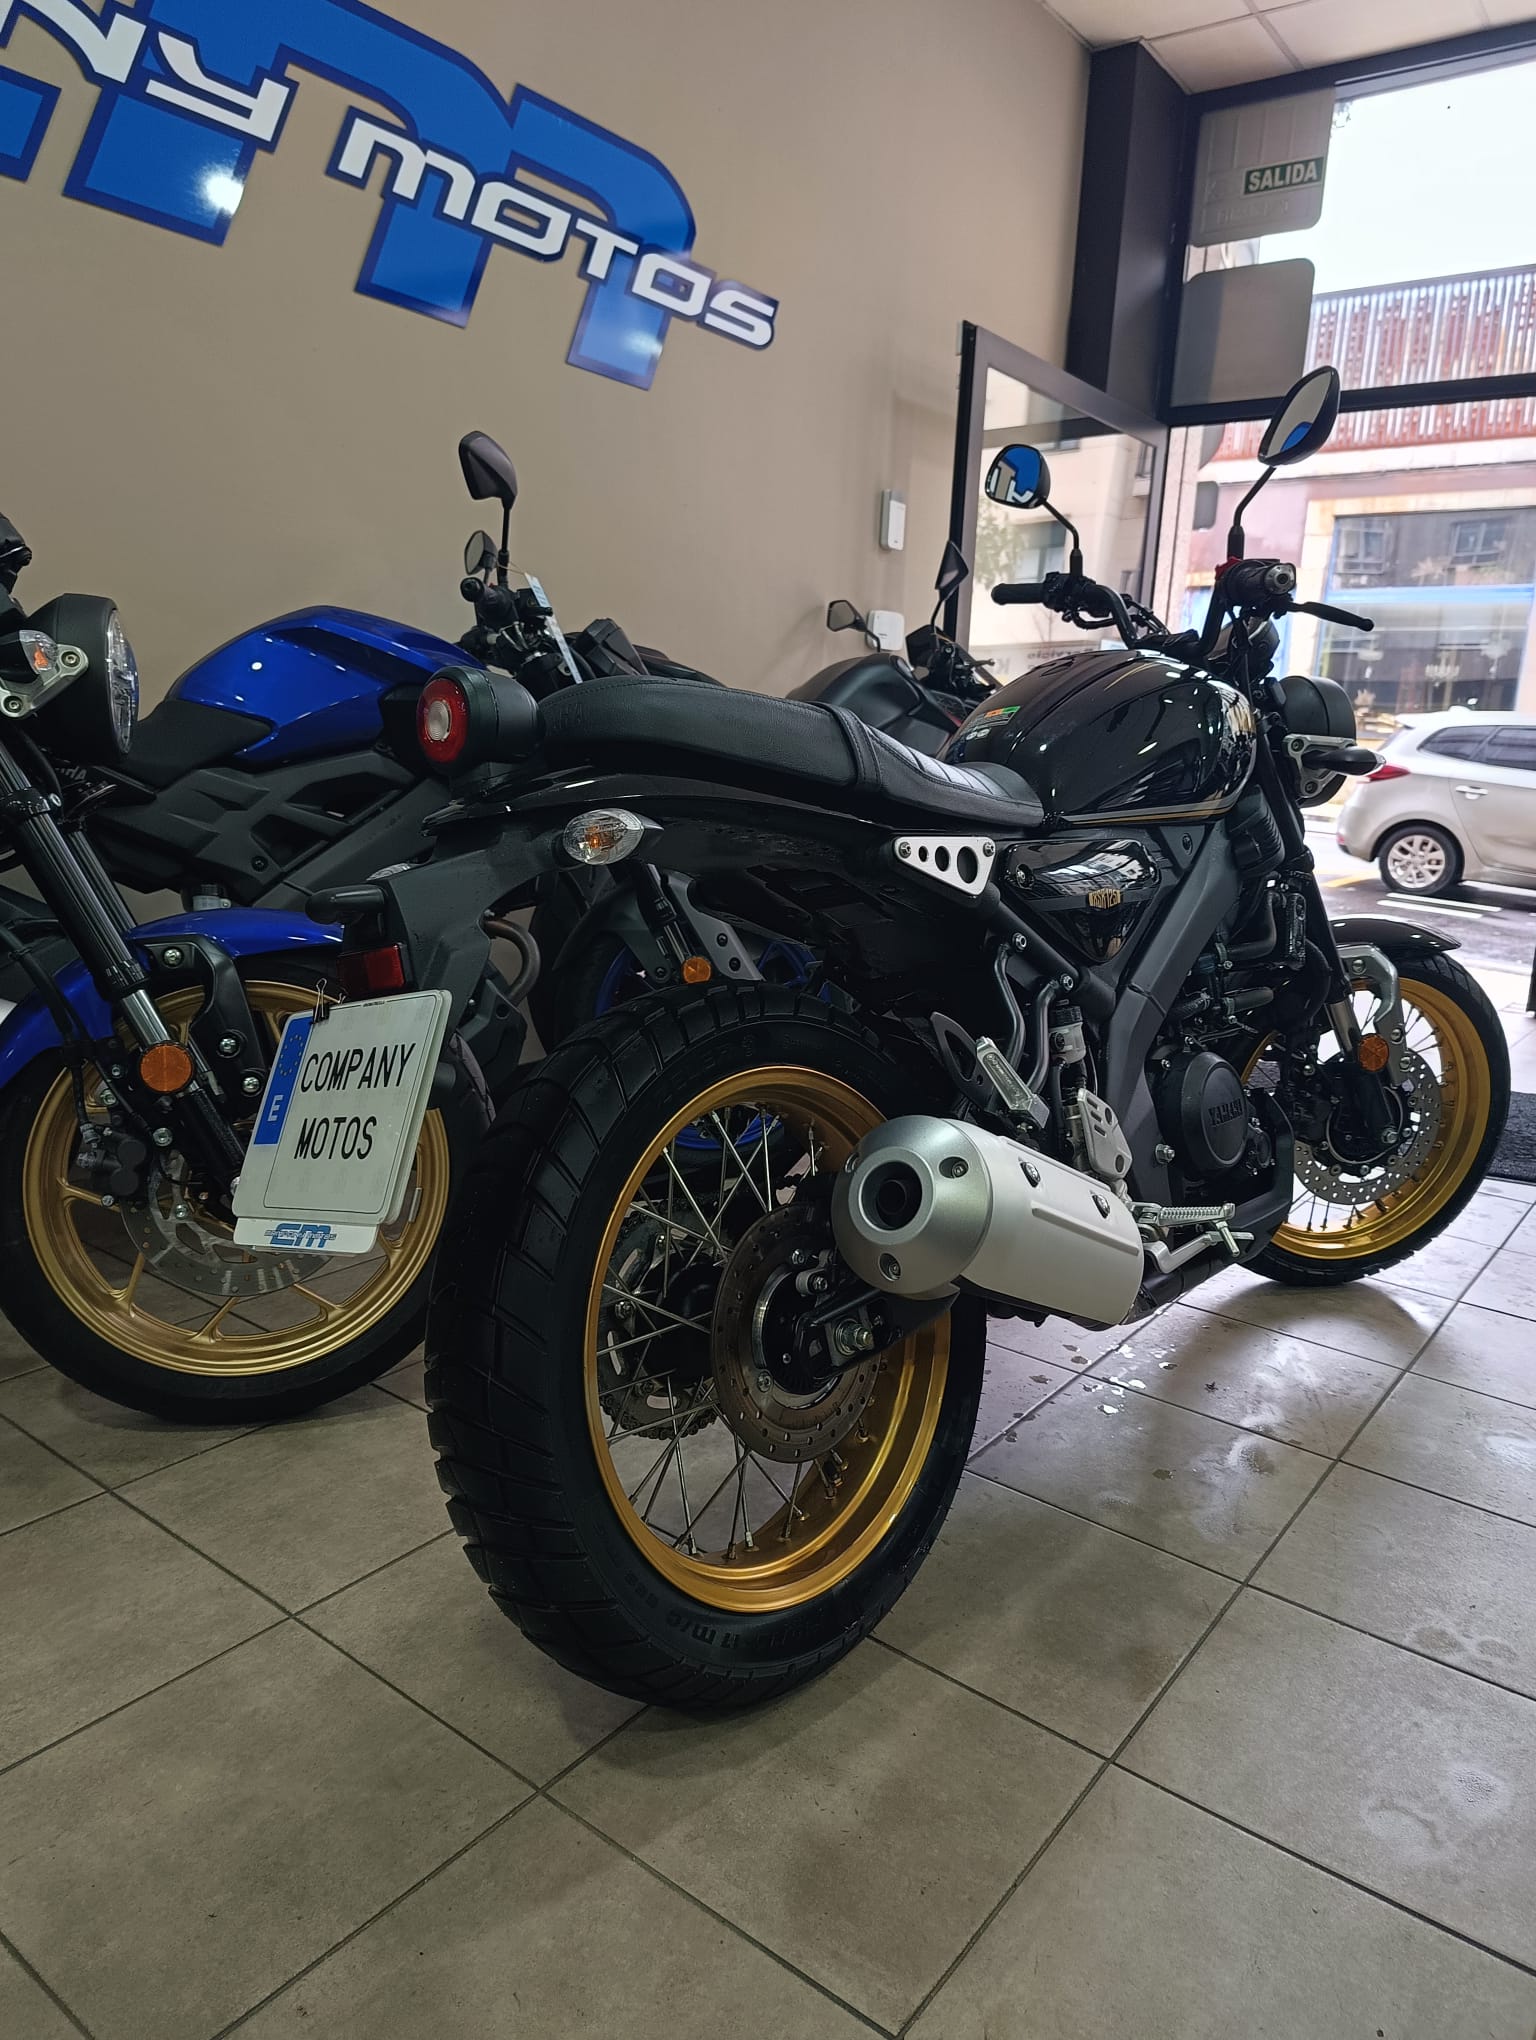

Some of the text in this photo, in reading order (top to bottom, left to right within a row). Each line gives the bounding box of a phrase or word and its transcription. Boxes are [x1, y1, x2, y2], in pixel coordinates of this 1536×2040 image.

[1247, 161, 1318, 192] SALIDA
[337, 117, 775, 347] MOTOS
[301, 1043, 416, 1093] COMPANY
[267, 1095, 284, 1122] E
[293, 1116, 377, 1160] MOTOS
